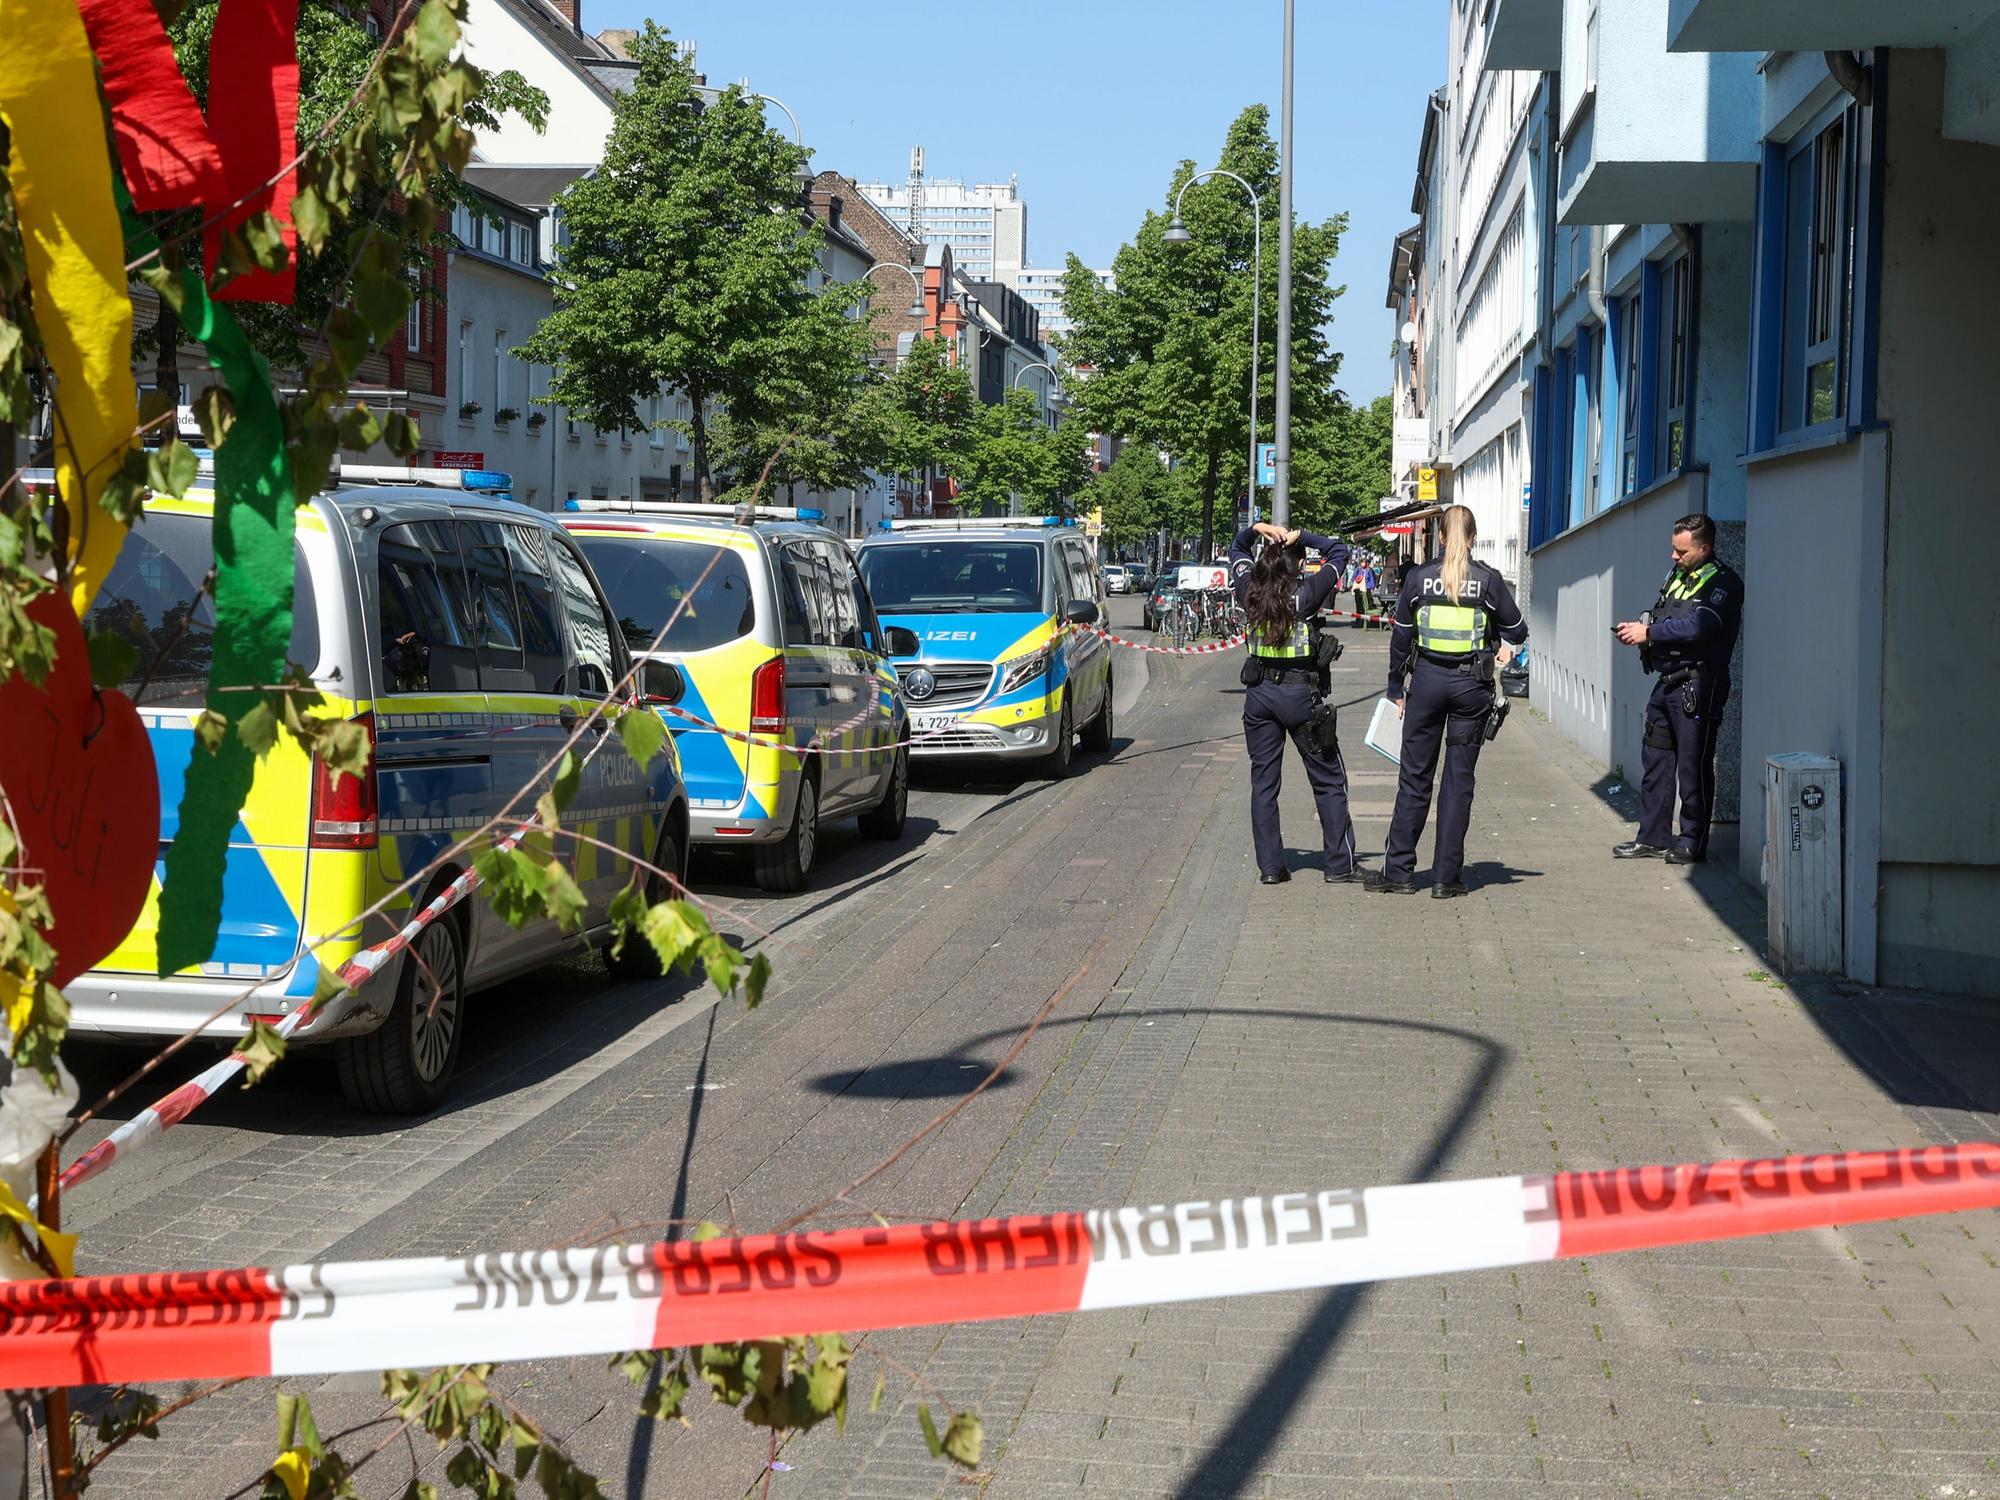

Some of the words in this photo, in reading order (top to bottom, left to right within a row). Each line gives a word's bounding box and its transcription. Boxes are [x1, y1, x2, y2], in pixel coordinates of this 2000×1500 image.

[888, 495, 896, 507] TV
[1423, 578, 1482, 598] POZEI
[915, 631, 977, 641] LIZEI
[600, 754, 635, 787] POLIZEI
